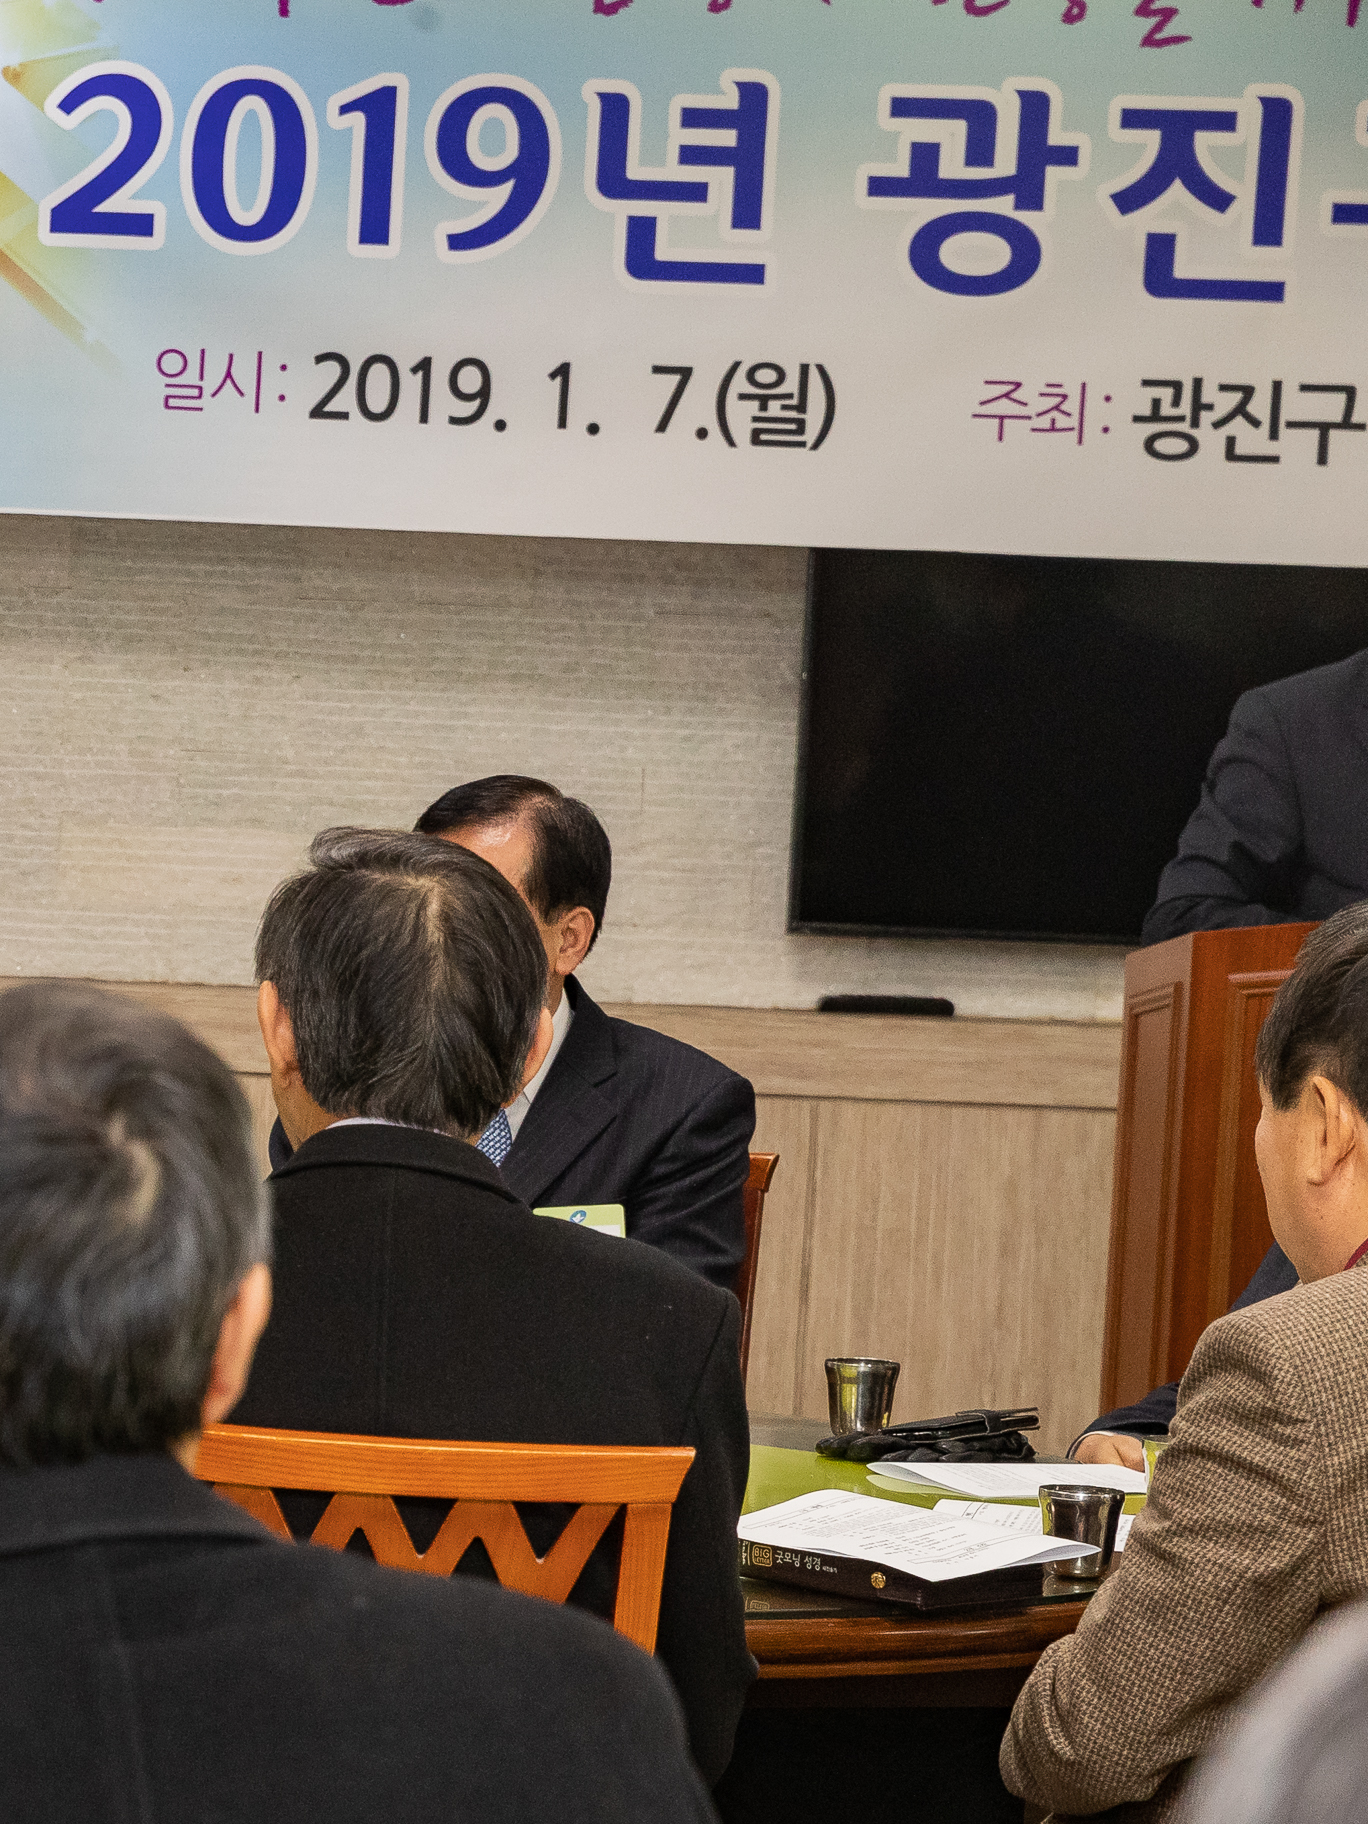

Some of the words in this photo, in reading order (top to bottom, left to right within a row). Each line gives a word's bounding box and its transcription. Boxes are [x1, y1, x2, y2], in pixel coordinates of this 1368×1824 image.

[47, 71, 770, 286] 2019년
[866, 88, 1368, 303] 광진
[155, 347, 289, 414] 일시:
[308, 351, 508, 433] 2019.
[547, 361, 601, 436] 1.
[650, 360, 836, 452] 7.(월)
[971, 380, 1112, 446] 주최:
[1131, 376, 1368, 467] 광진구
[754, 1547, 770, 1559] BIG
[774, 1550, 801, 1567] 굿모닝
[803, 1555, 821, 1571] 성경
